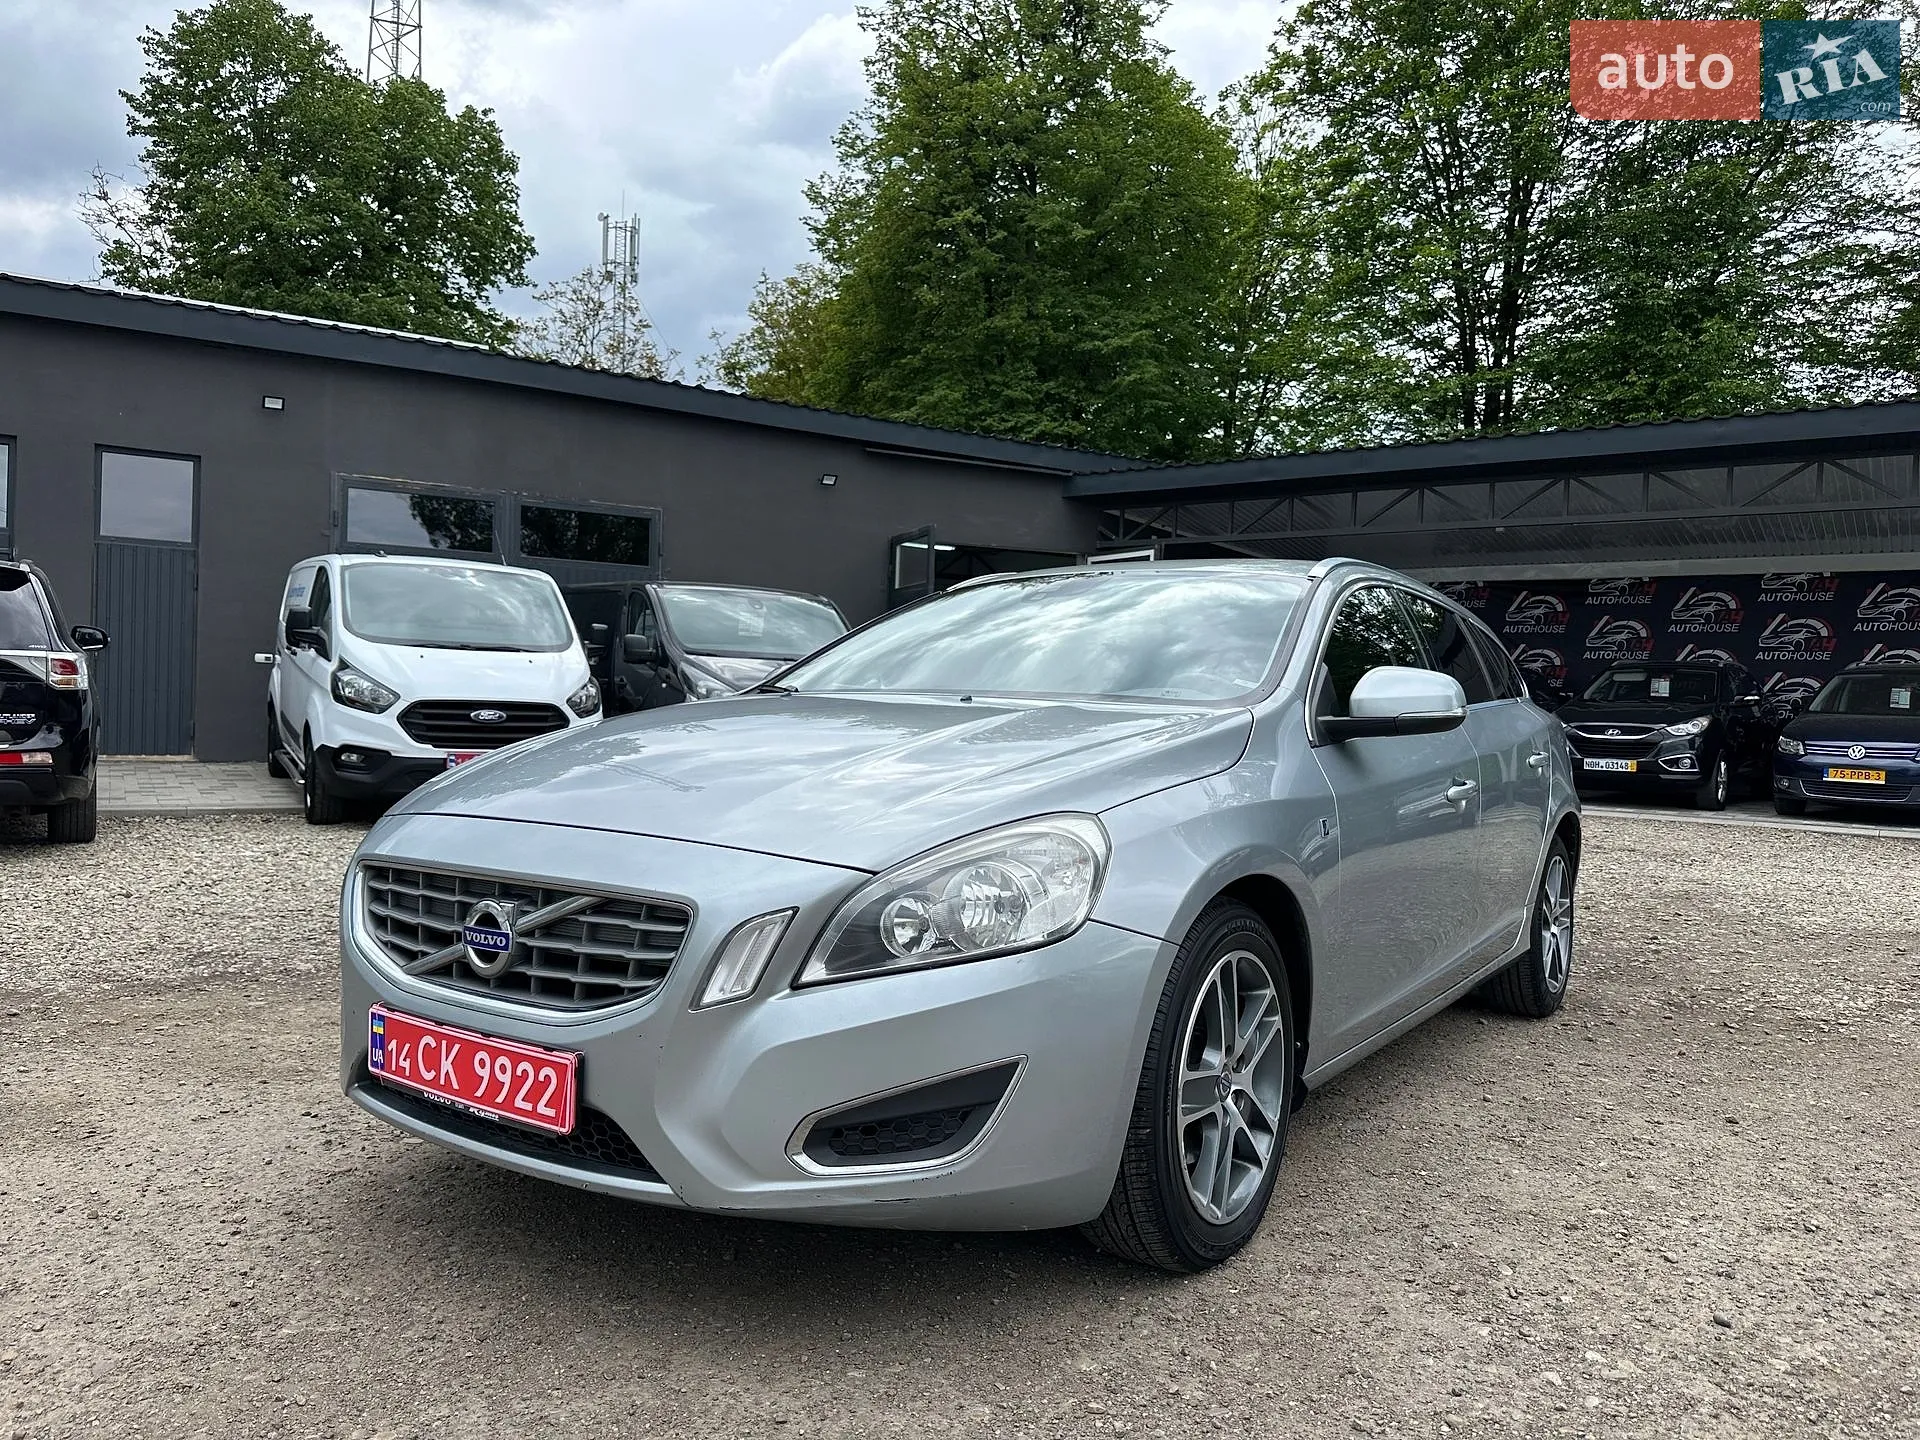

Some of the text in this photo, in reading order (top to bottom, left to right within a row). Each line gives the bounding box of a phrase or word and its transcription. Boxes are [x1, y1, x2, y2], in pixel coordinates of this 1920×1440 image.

[1585, 595, 1653, 605] AUTOHOUSE
[1757, 591, 1835, 602] AUTOHOUSE
[1502, 624, 1565, 634] AUTOHOUSE
[1667, 623, 1740, 633] AUTOHOUSE
[1582, 650, 1650, 660] AUTOHOUSE
[1755, 651, 1832, 661] AUTOHOUSE
[1832, 769, 1881, 781] 75-PPB-3
[464, 930, 507, 947] VOLVO
[372, 1047, 384, 1064] UA
[473, 1050, 559, 1118] 9922
